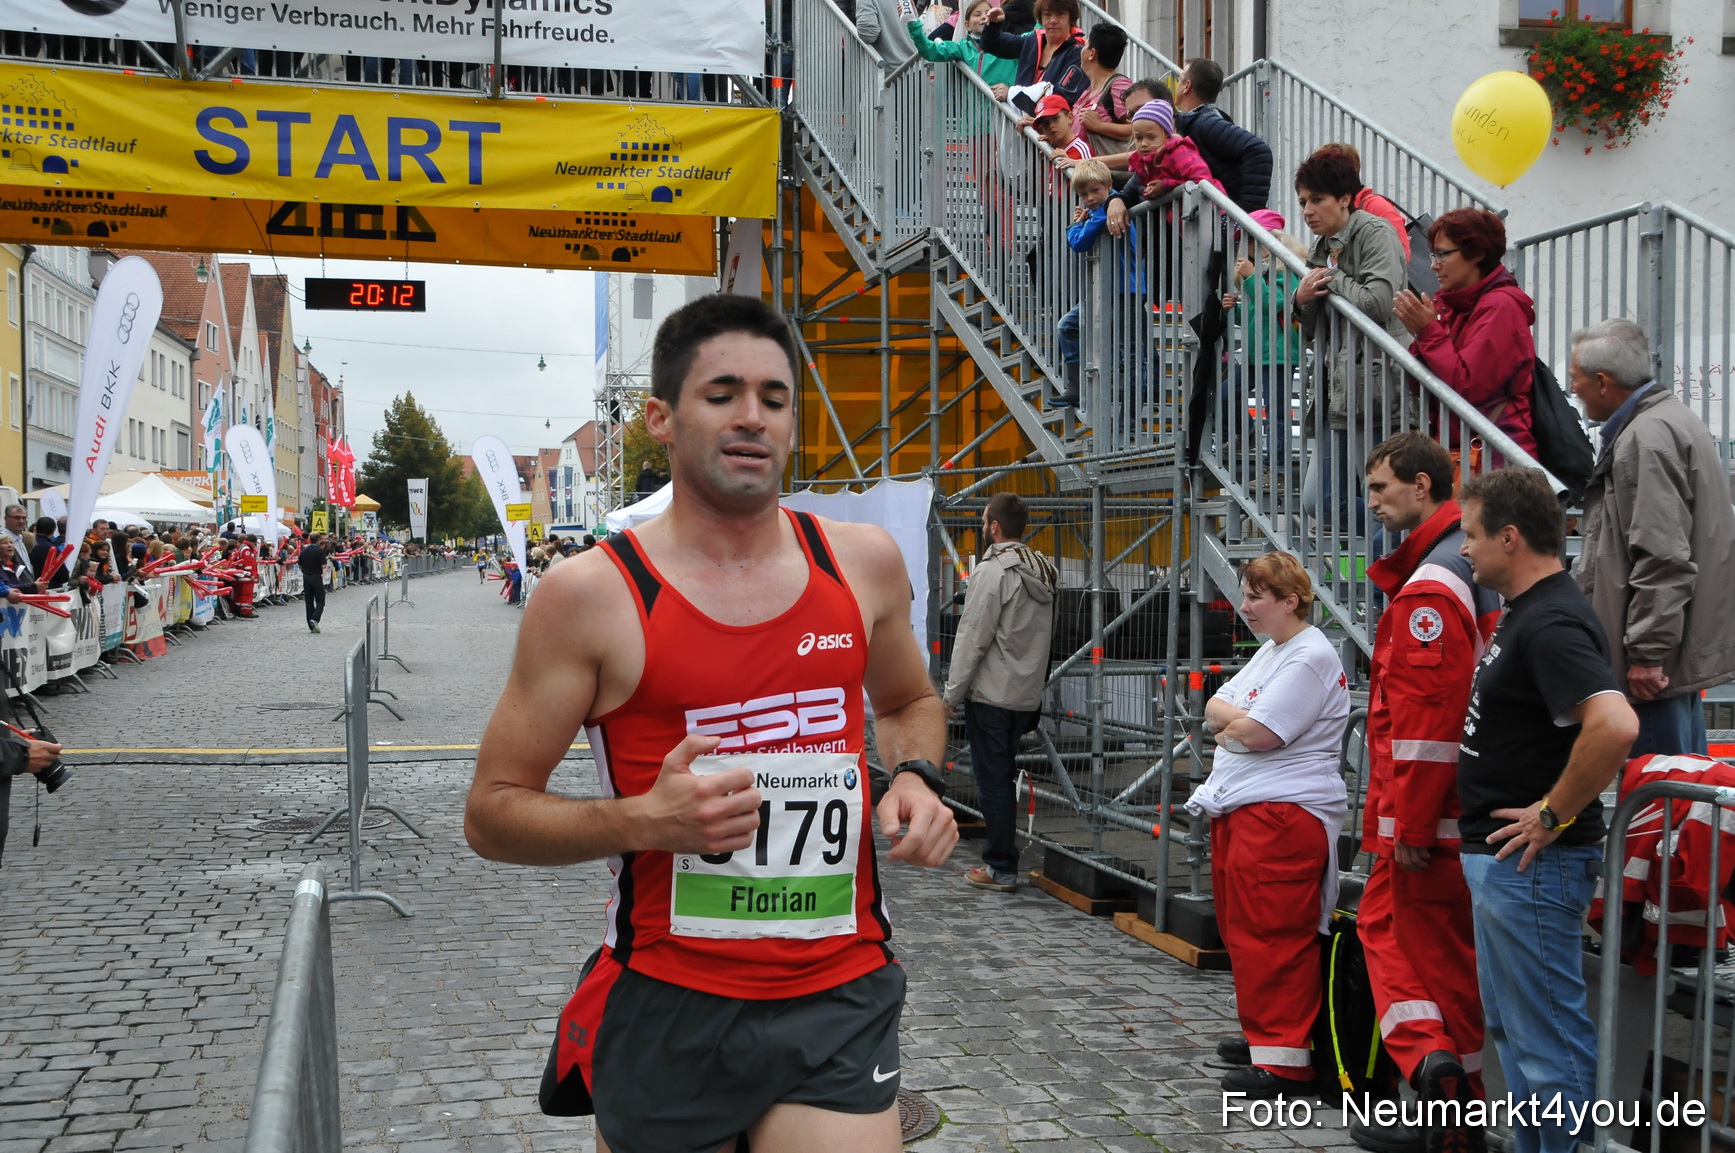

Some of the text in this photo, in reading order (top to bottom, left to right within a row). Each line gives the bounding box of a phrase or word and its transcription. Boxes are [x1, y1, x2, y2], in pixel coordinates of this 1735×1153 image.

[159, 0, 266, 25] Weniger
[270, 3, 405, 32] Verbrauch.
[412, 13, 475, 36] Mehr
[48, 133, 138, 154] Stadtlauf
[194, 106, 501, 186] START
[555, 161, 733, 182] Neumarkter Stadtlauf
[0, 198, 168, 218] eumarkter Stadtlauf
[528, 225, 683, 243] Neumarkter Stadtlauf
[350, 283, 414, 306] 20:12
[85, 359, 121, 474] Audi BKK
[315, 517, 324, 528] A
[816, 632, 853, 650] asics
[685, 686, 848, 749] ESB
[756, 772, 839, 789] Neumarkt
[699, 798, 849, 866] 179
[681, 858, 690, 870] S
[730, 885, 817, 913] Florian
